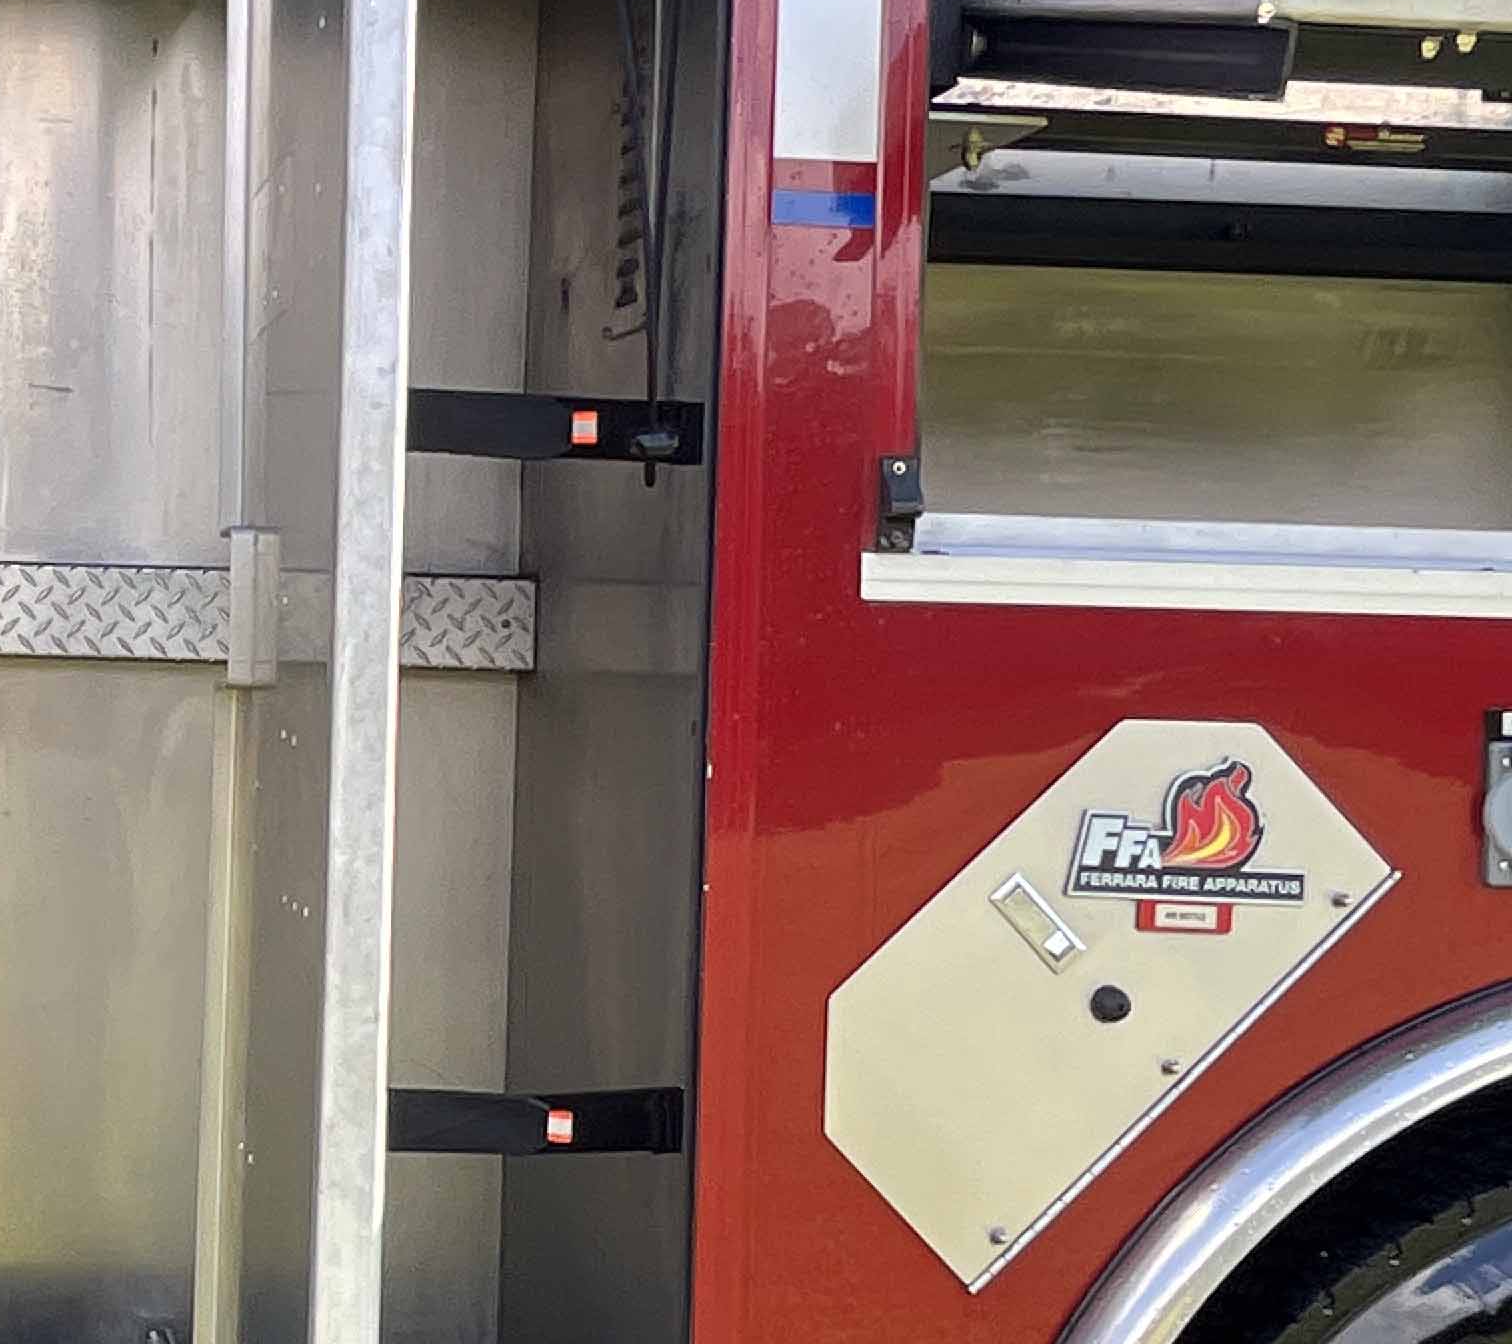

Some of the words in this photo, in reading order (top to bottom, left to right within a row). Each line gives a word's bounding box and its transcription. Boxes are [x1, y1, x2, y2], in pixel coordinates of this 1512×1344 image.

[1082, 815, 1162, 870] FFA
[1079, 871, 1158, 889] FERRARA
[1162, 875, 1200, 891] FIRE
[1204, 876, 1301, 895] APPARATUS
